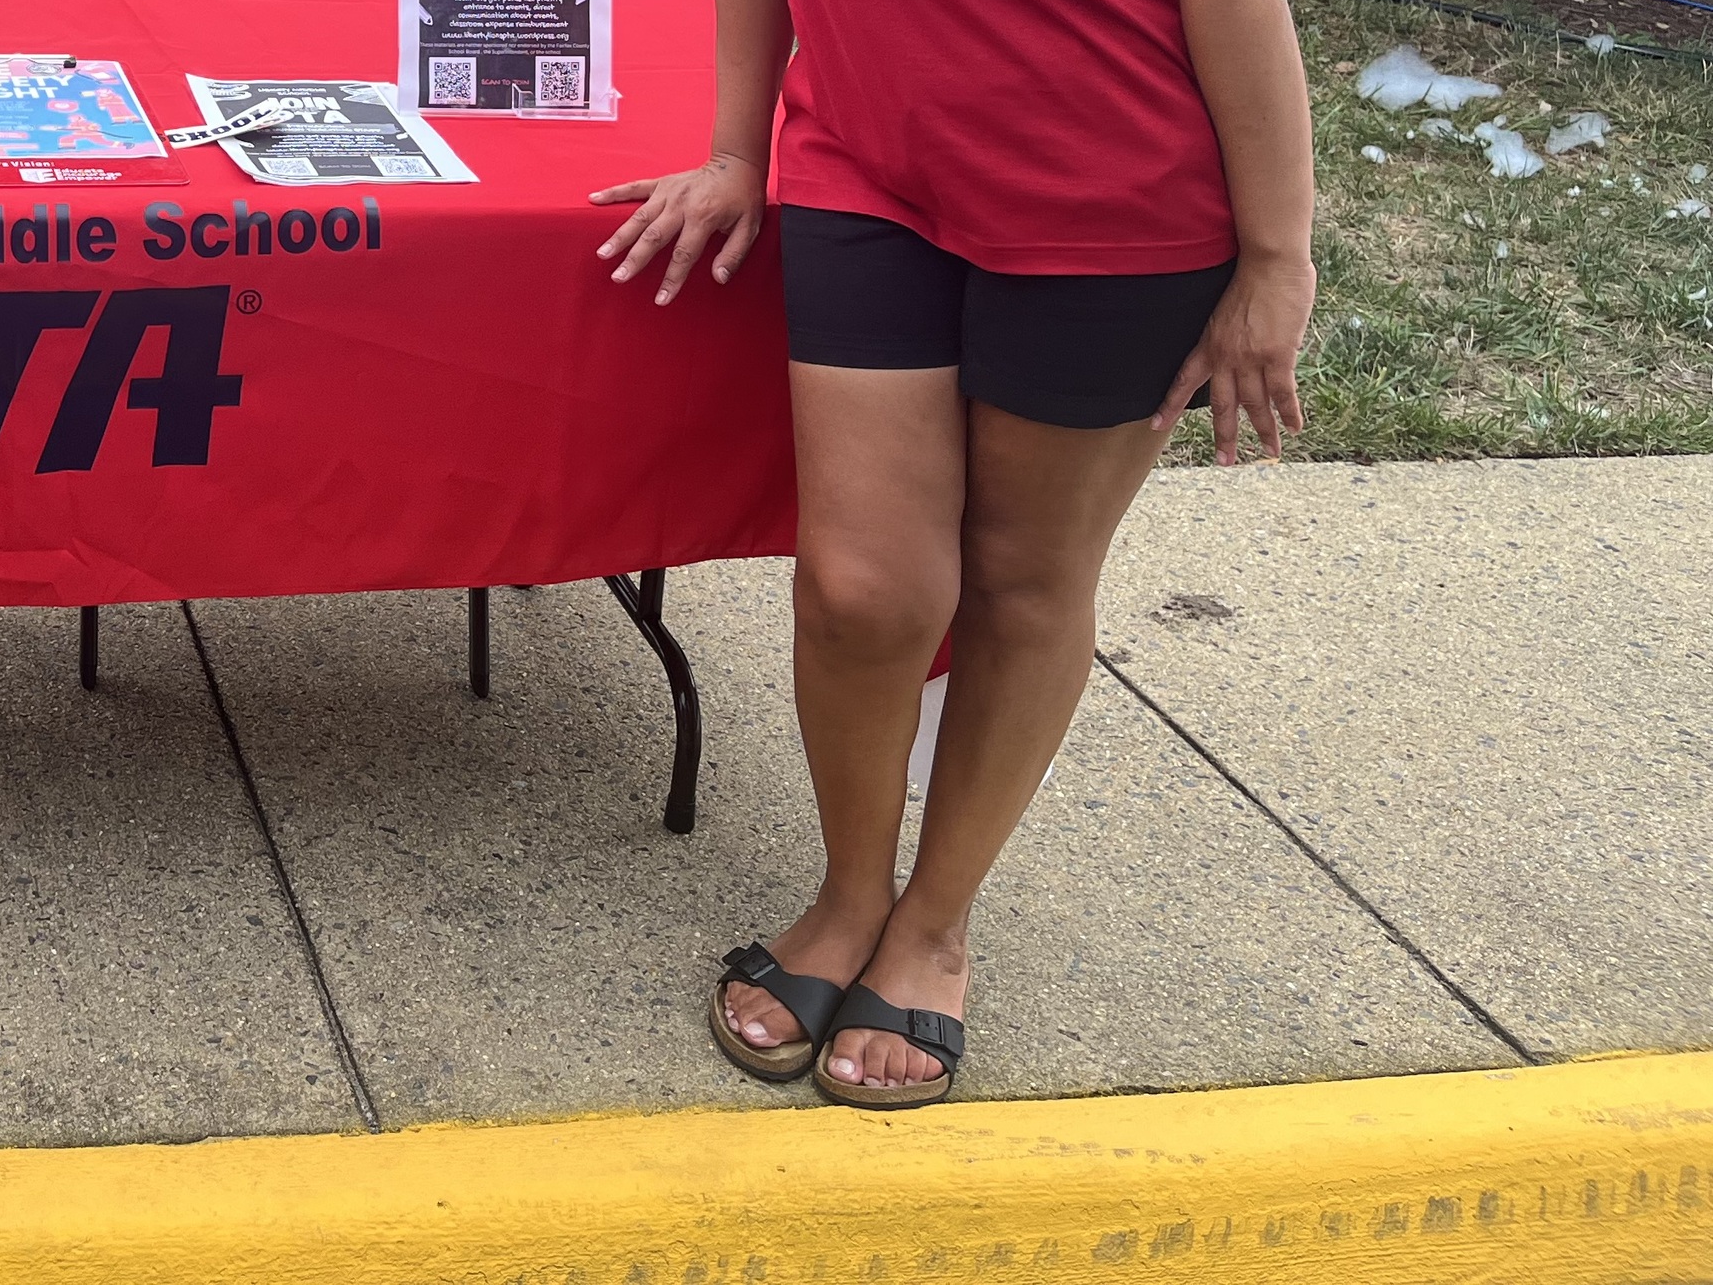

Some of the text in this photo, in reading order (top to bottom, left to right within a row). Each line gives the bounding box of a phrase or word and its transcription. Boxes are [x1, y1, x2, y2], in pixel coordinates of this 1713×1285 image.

[533, 3, 555, 11] direct
[485, 21, 514, 29] expense
[515, 20, 568, 28] reimbursement
[481, 78, 501, 86] SCAN
[501, 78, 511, 86] TO
[143, 196, 382, 261] School
